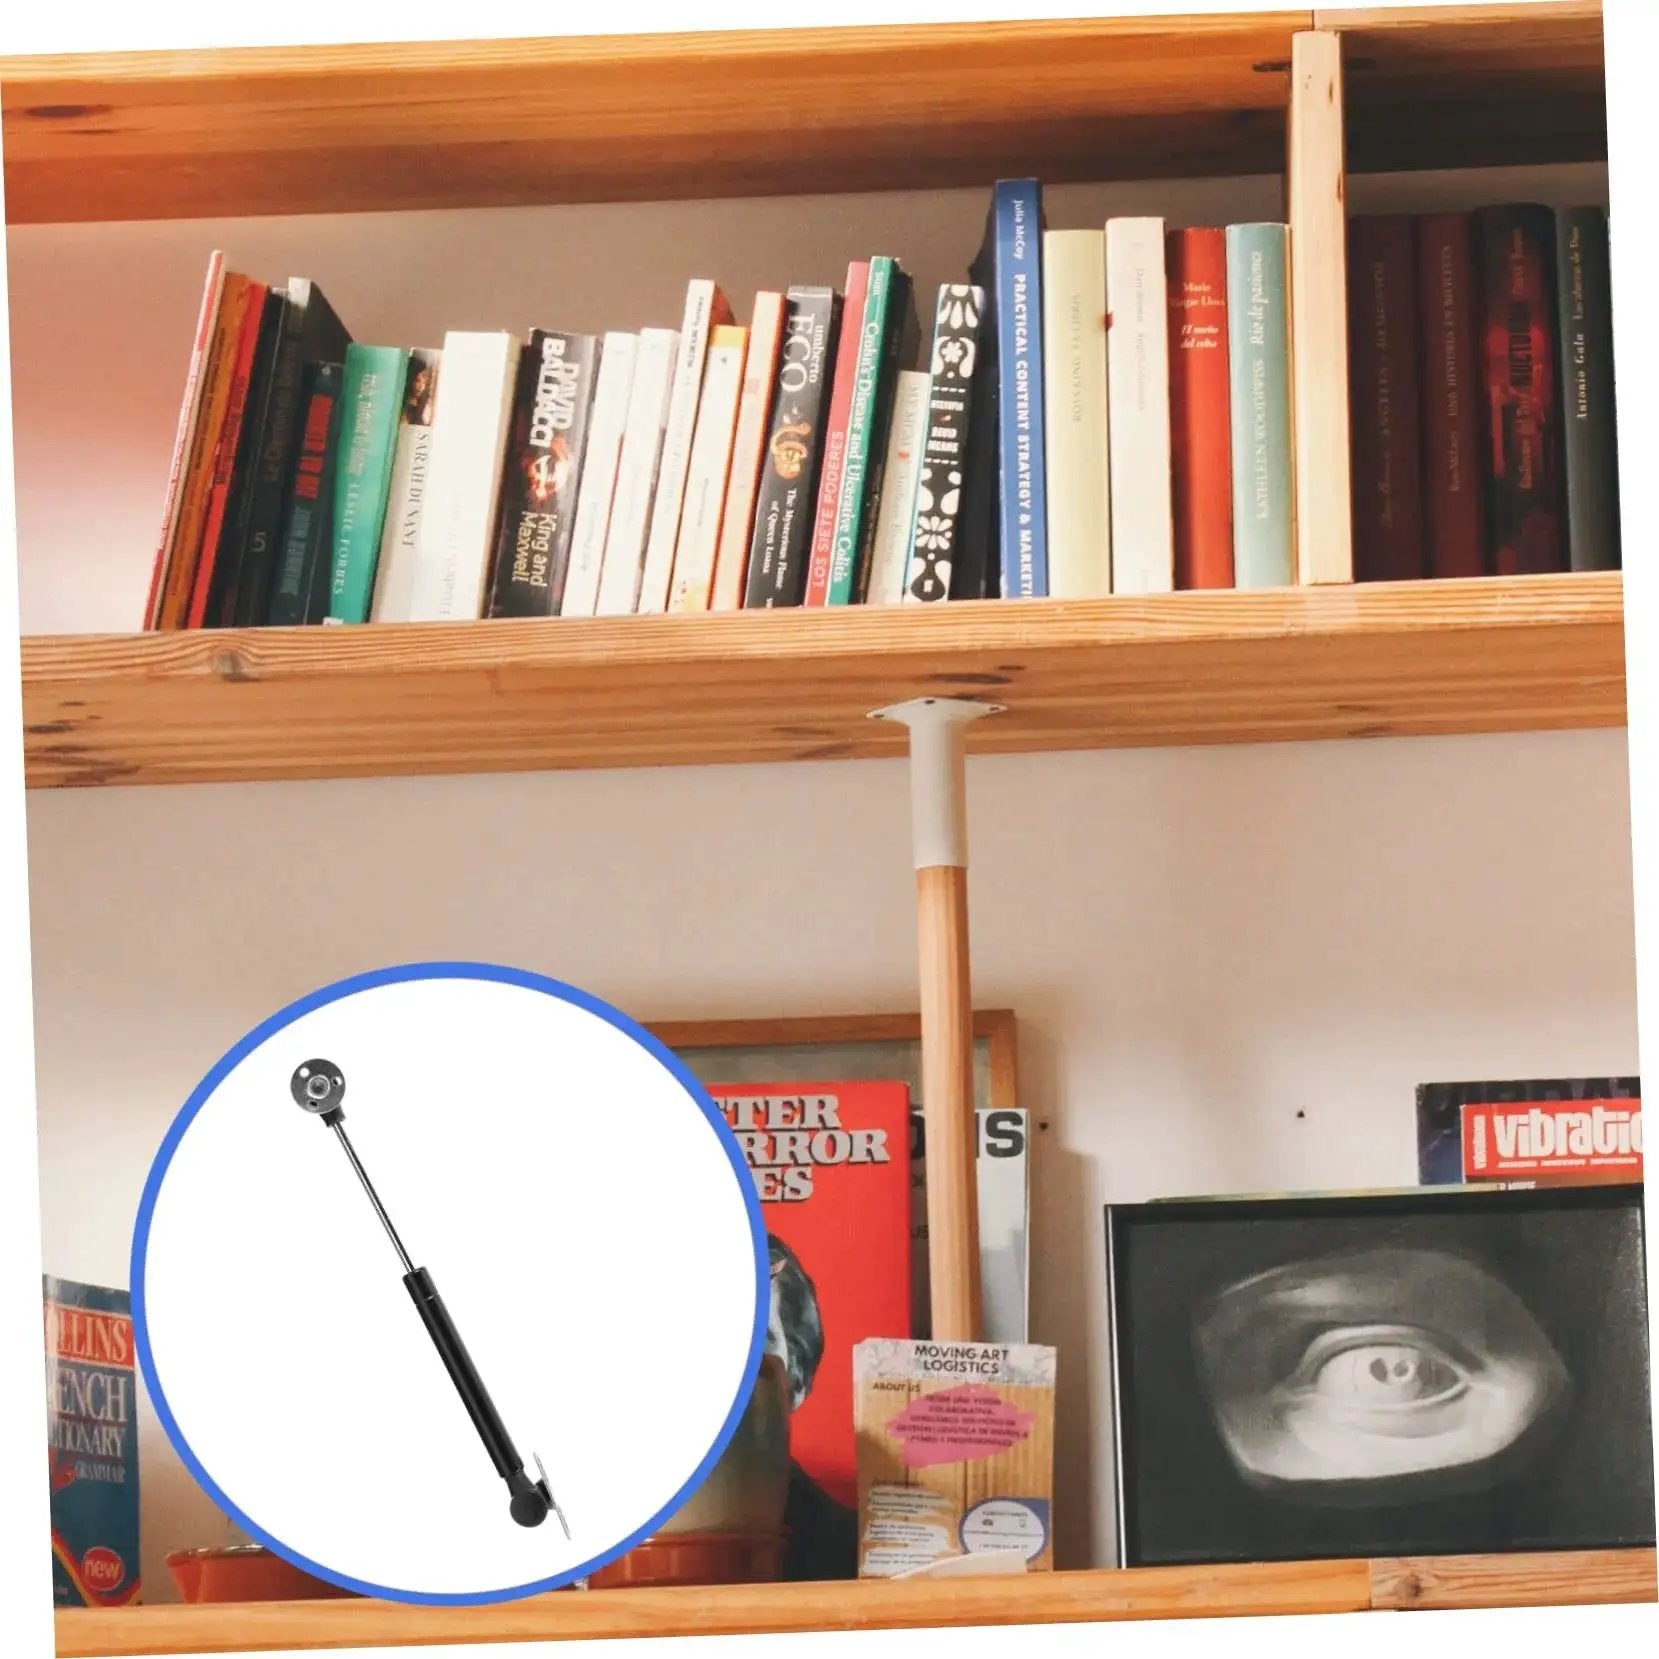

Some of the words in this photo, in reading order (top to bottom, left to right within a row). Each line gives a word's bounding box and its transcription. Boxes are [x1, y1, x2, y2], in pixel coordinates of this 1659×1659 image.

[1013, 199, 1023, 223] Julia
[1013, 225, 1026, 260] McCoy
[1013, 273, 1027, 356] PRACTICAL
[780, 313, 815, 392] ECO
[808, 325, 824, 384] umberto
[859, 322, 879, 374] Crohn's
[530, 337, 567, 448] BALDACCI
[555, 362, 580, 431] DAVID
[853, 379, 871, 428] Disease
[1016, 360, 1029, 431] CONTENT
[411, 431, 430, 484] SARAH
[822, 430, 845, 504] PODERES
[849, 433, 864, 459] and
[1018, 434, 1032, 510] STRATEGY
[786, 487, 798, 507] The
[839, 464, 861, 532] Ulcerative
[1020, 513, 1031, 524] &
[251, 531, 267, 553] 5
[512, 511, 537, 583] Maxwell
[532, 513, 558, 551] King
[816, 507, 834, 552] SIETE
[333, 536, 352, 596] FORBES
[530, 553, 549, 588] and
[812, 555, 829, 588] LOS
[833, 537, 852, 583] Colitis
[735, 1130, 891, 1167] RROR
[751, 1167, 814, 1202] ES
[914, 1345, 977, 1361] MOVING
[980, 1349, 1009, 1361] ART
[923, 1360, 1000, 1375] LOGISTICS
[872, 1381, 906, 1392] ABOUT
[907, 1383, 921, 1393] US
[84, 1560, 121, 1581] new
